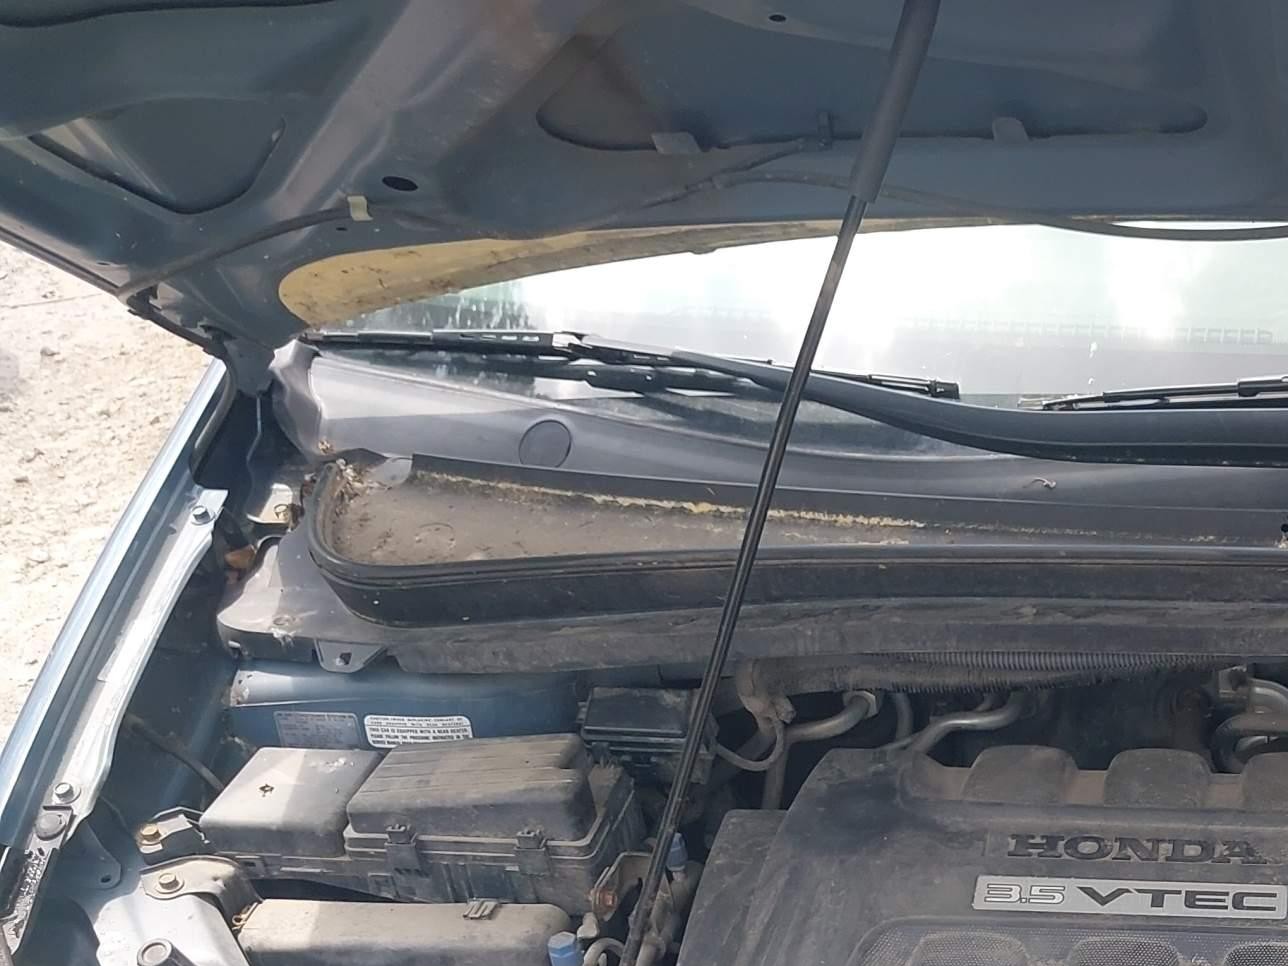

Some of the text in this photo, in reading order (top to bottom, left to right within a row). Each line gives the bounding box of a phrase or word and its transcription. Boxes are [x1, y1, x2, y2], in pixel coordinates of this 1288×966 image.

[1008, 833, 1267, 864] HONDA
[984, 883, 1278, 912] 3.5 VTEC
